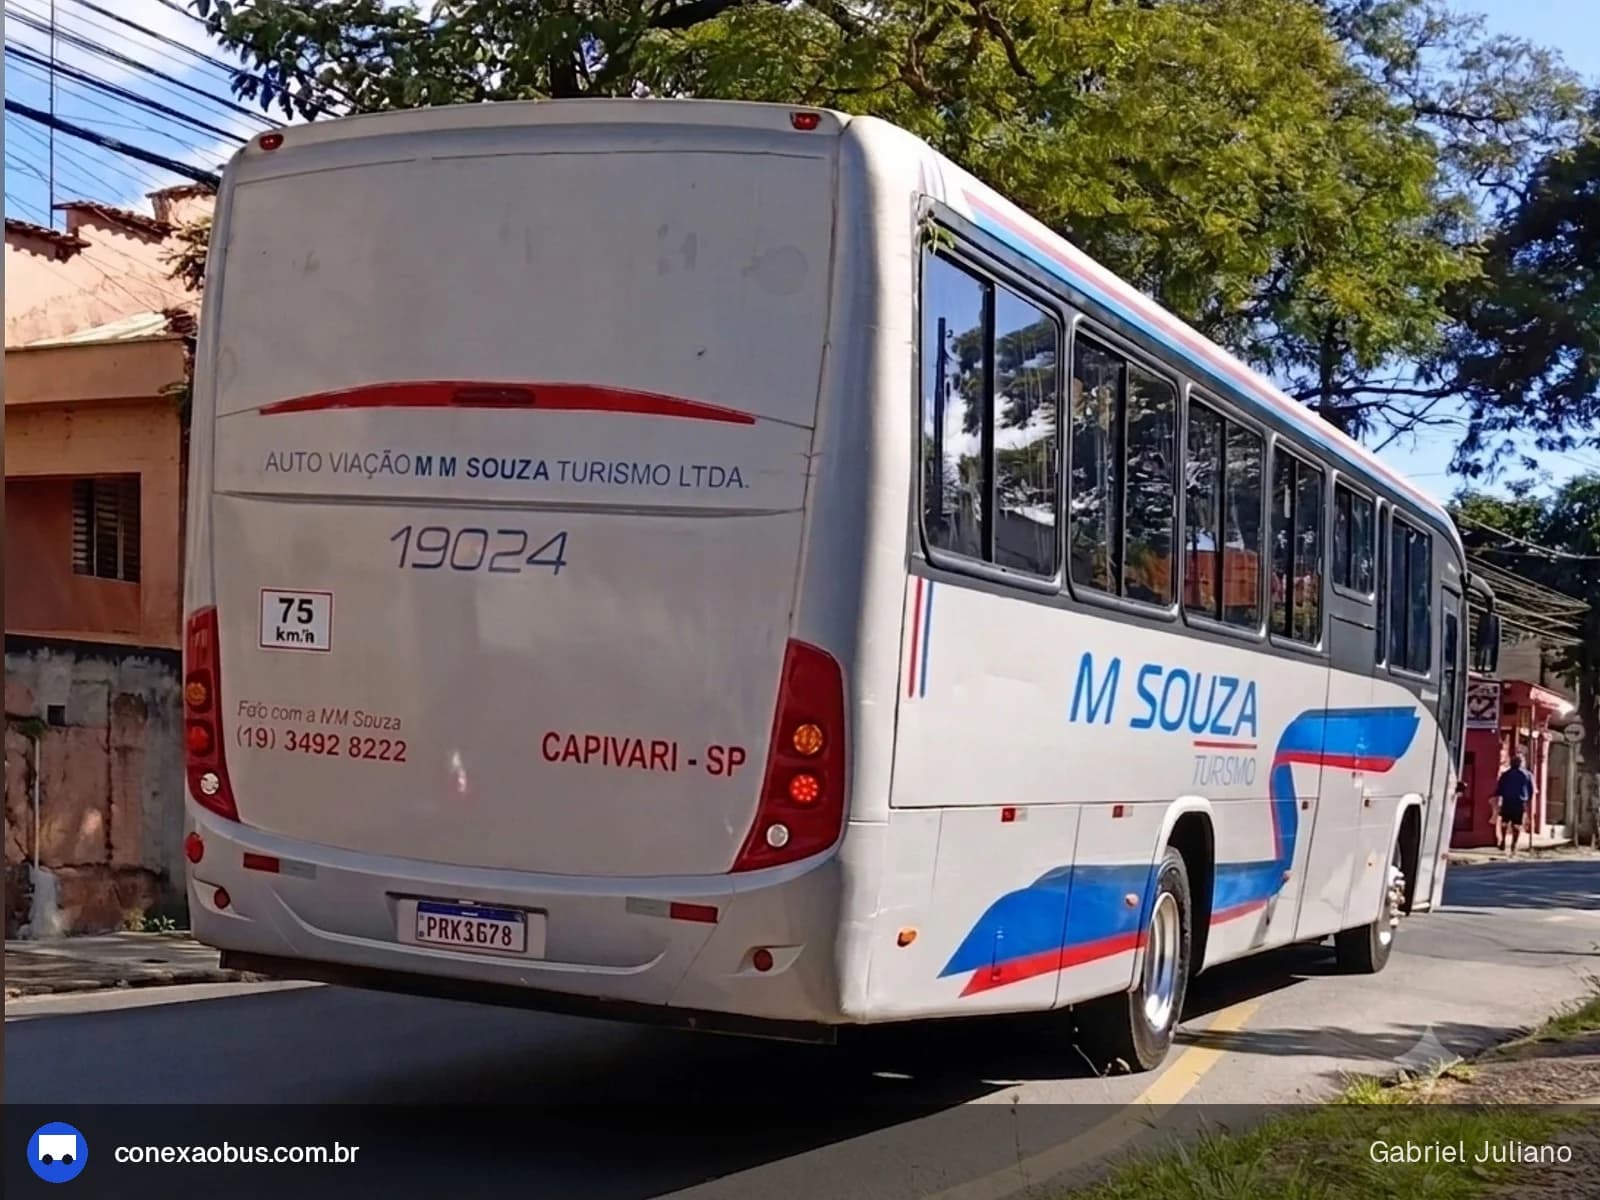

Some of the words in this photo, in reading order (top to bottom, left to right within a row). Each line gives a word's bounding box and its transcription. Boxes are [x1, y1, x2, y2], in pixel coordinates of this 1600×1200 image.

[265, 451, 322, 473] AUTO
[328, 449, 411, 479] VIAÇÃO
[466, 457, 550, 480] SOUZA
[557, 460, 671, 486] TURISMO
[679, 465, 750, 488] LTDA.
[390, 525, 569, 575] 19024
[279, 598, 314, 624] 75
[271, 706, 302, 721] com
[306, 709, 316, 723] a
[353, 709, 401, 730] Souza
[1129, 663, 1258, 738] SOUZA
[236, 724, 276, 749] (19)
[284, 729, 341, 757] 3492
[348, 736, 407, 763] 8222
[542, 731, 678, 772] CAPIVARI
[706, 744, 747, 777] SP
